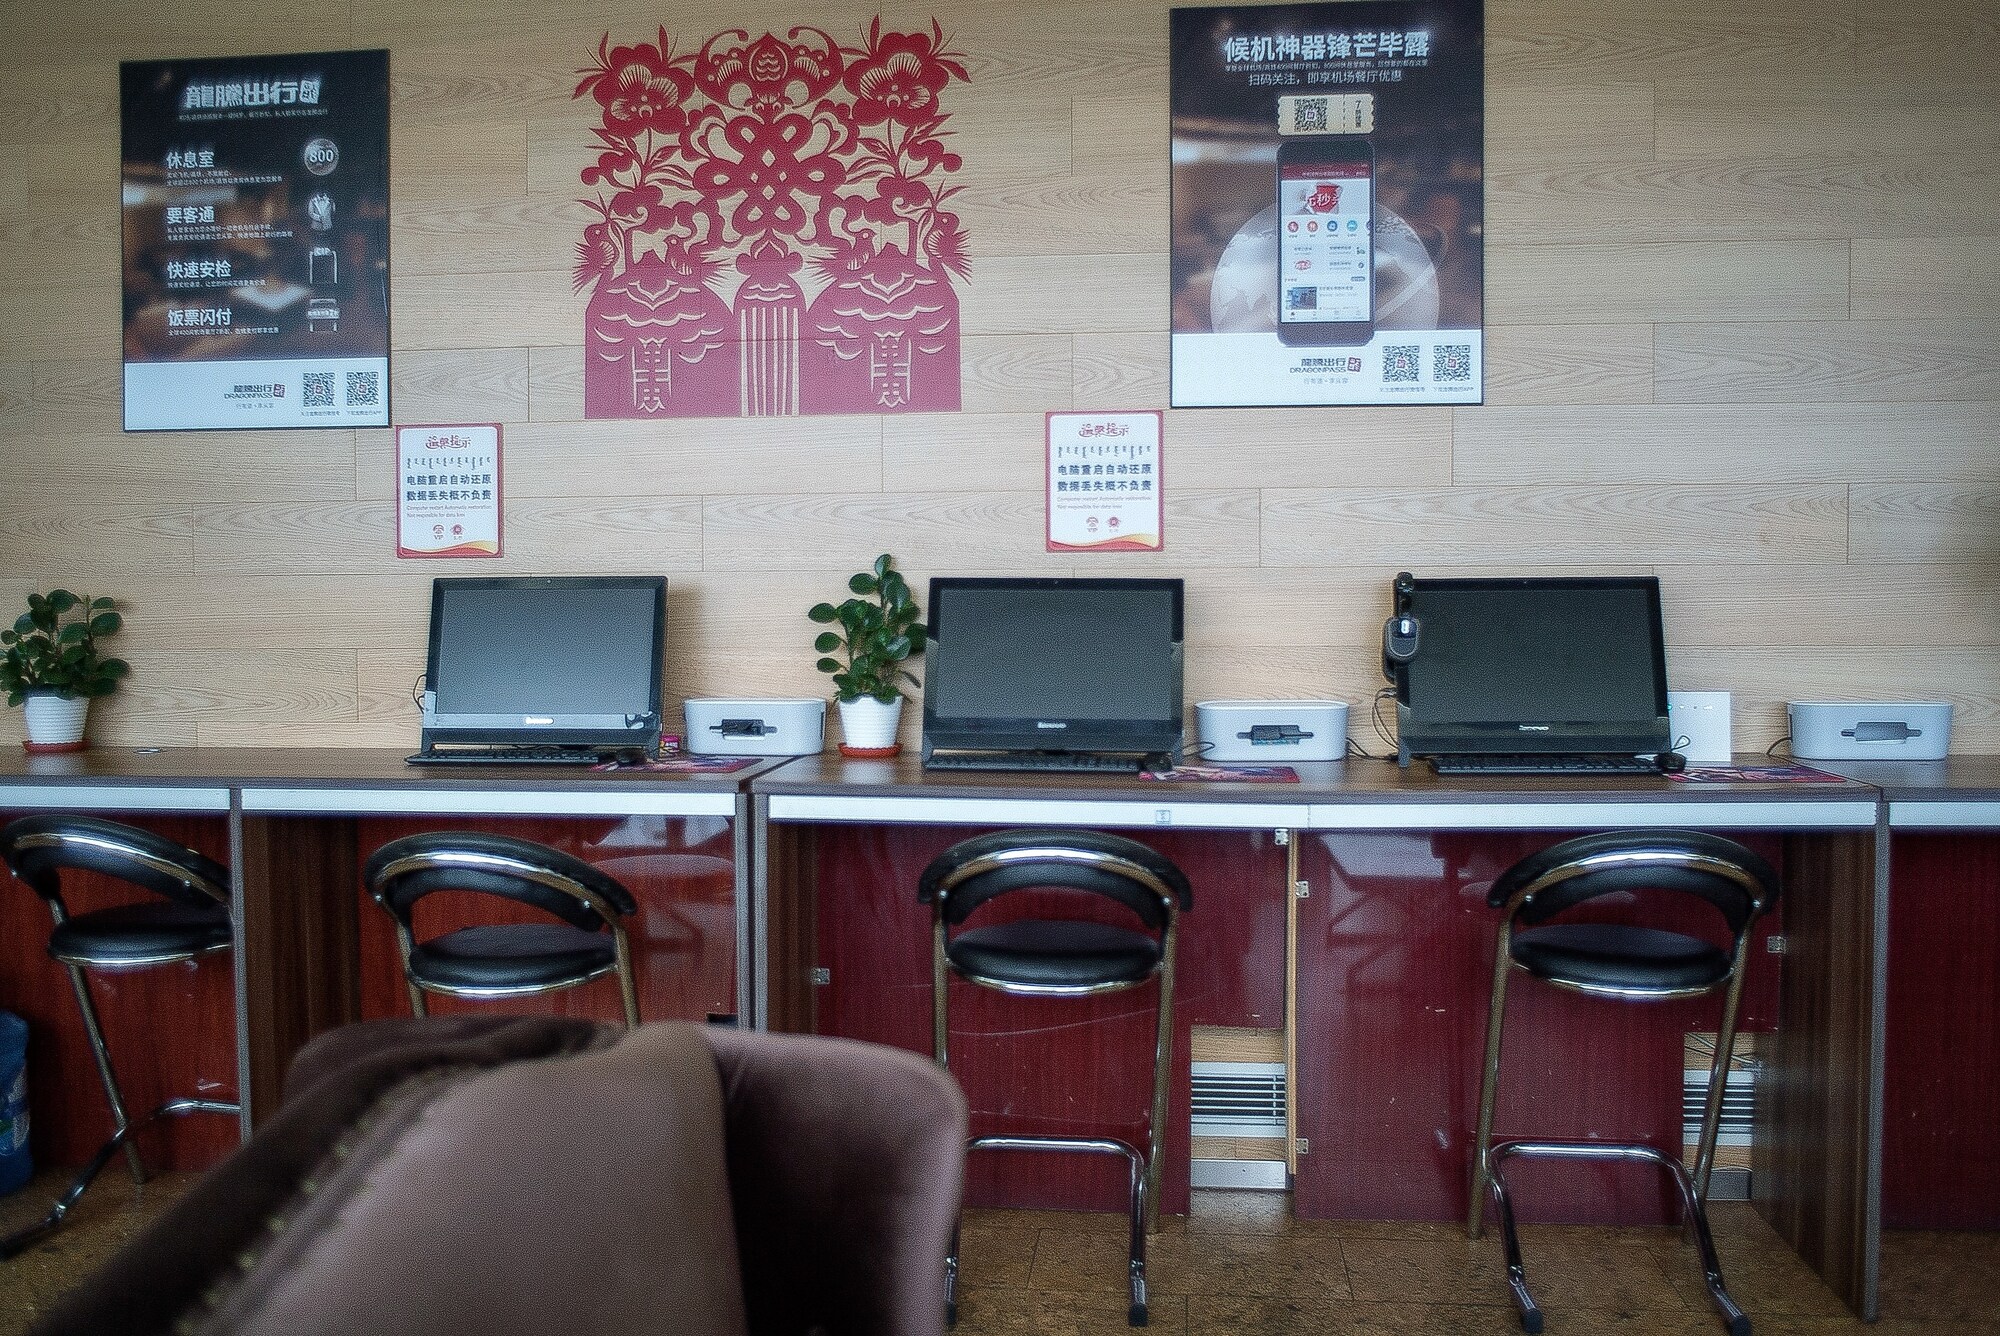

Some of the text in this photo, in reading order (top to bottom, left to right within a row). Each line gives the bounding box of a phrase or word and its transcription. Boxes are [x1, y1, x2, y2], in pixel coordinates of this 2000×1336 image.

[1225, 32, 1430, 62] 候机神器锋芒毕露
[166, 151, 215, 170] 休息室
[309, 149, 334, 163] 800
[166, 206, 215, 224] 要客通
[166, 260, 232, 279] 快速安检
[167, 308, 232, 327] 饭票闪付
[1289, 366, 1347, 374] DRAGONPASS
[1078, 422, 1130, 438] 温馨提示
[425, 434, 471, 450] 温馨提示
[1057, 463, 1152, 476] 电脑重启自动还原
[406, 474, 492, 486] 电脑重启自动还原
[1057, 480, 1152, 492] 数据丢失概不负责
[406, 489, 492, 501] 数据丢失概不负责
